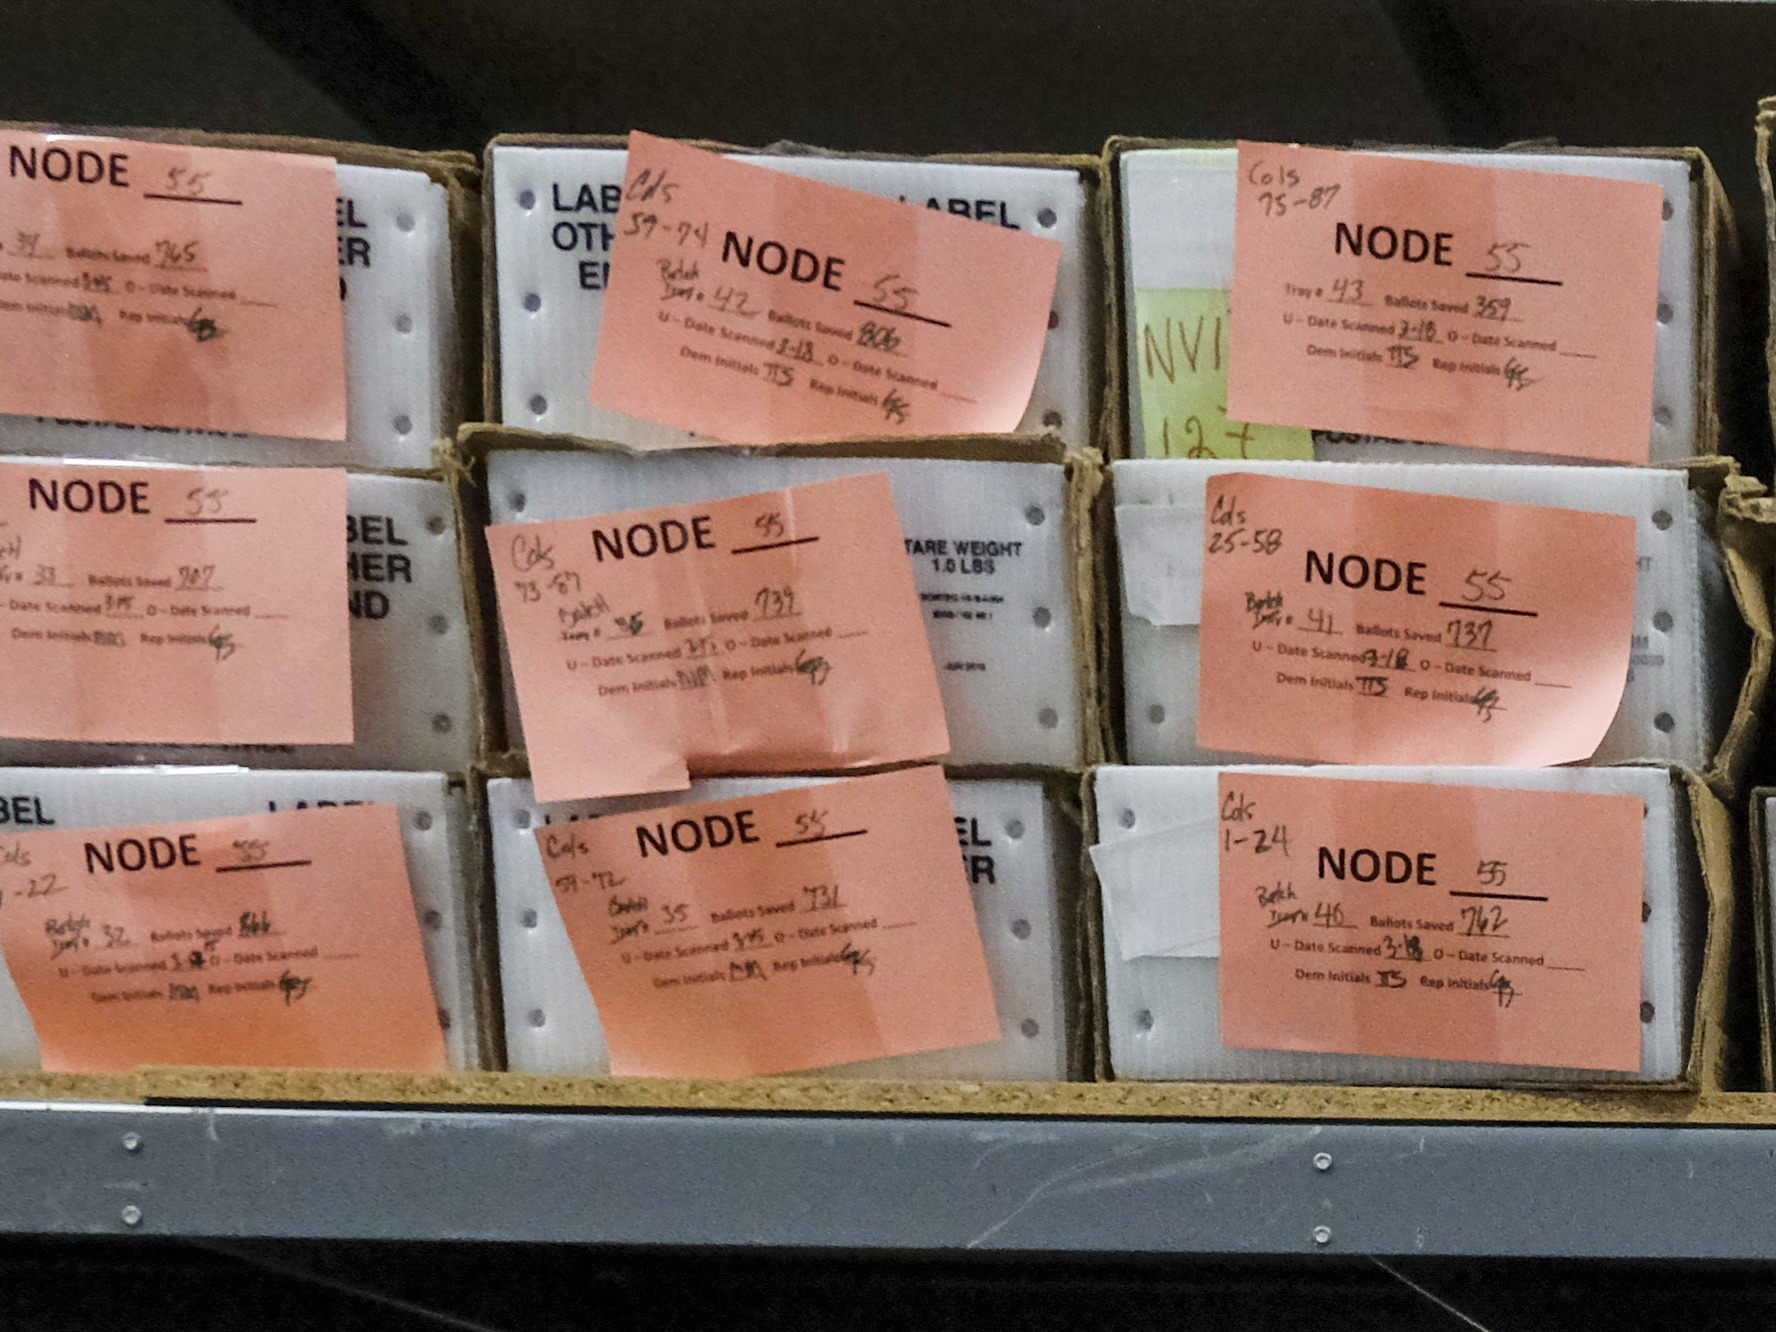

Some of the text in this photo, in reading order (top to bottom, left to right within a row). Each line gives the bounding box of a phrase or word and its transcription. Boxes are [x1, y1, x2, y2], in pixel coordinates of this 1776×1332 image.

[11, 146, 128, 186] NODE
[723, 232, 844, 290] NODE
[1336, 223, 1532, 273] NODE 55
[30, 479, 149, 513] NODE
[593, 517, 714, 561] NODE
[1306, 551, 1510, 602] NODE 55
[85, 836, 200, 873] NODE
[637, 811, 759, 857] NODE
[1319, 847, 1507, 886] NODE 55
